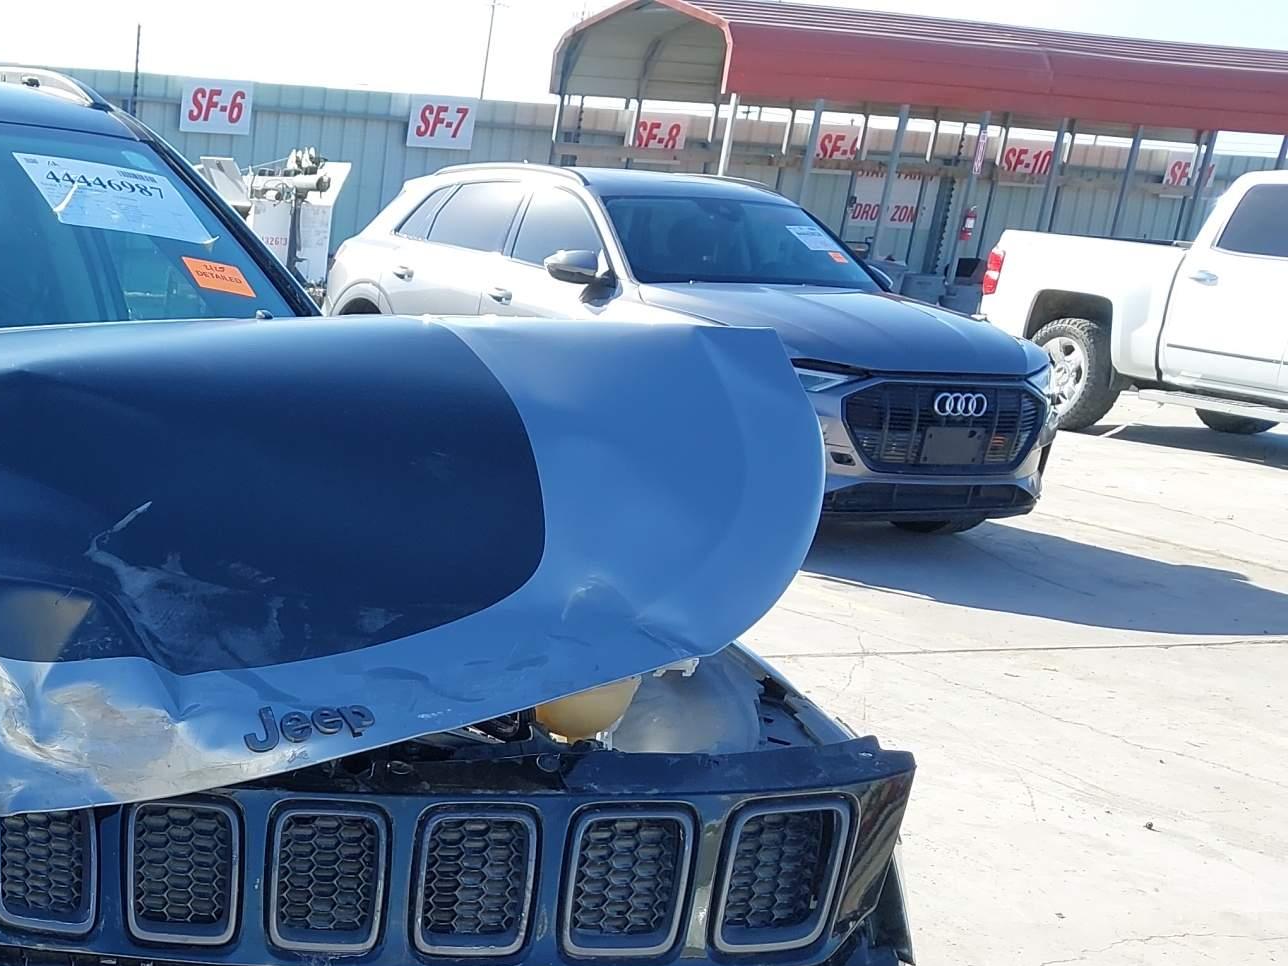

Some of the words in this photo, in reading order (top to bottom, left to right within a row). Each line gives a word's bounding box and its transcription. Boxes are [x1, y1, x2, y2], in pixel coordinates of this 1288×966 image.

[188, 87, 245, 124] SF-6
[415, 104, 469, 139] SF-7
[637, 120, 681, 149] SF-8
[1004, 147, 1053, 175] SF-10
[45, 170, 165, 200] 44446987
[851, 202, 889, 221] DRO
[890, 204, 919, 223] ZON
[195, 269, 243, 284] DETAILED
[243, 705, 376, 753] Jeep
